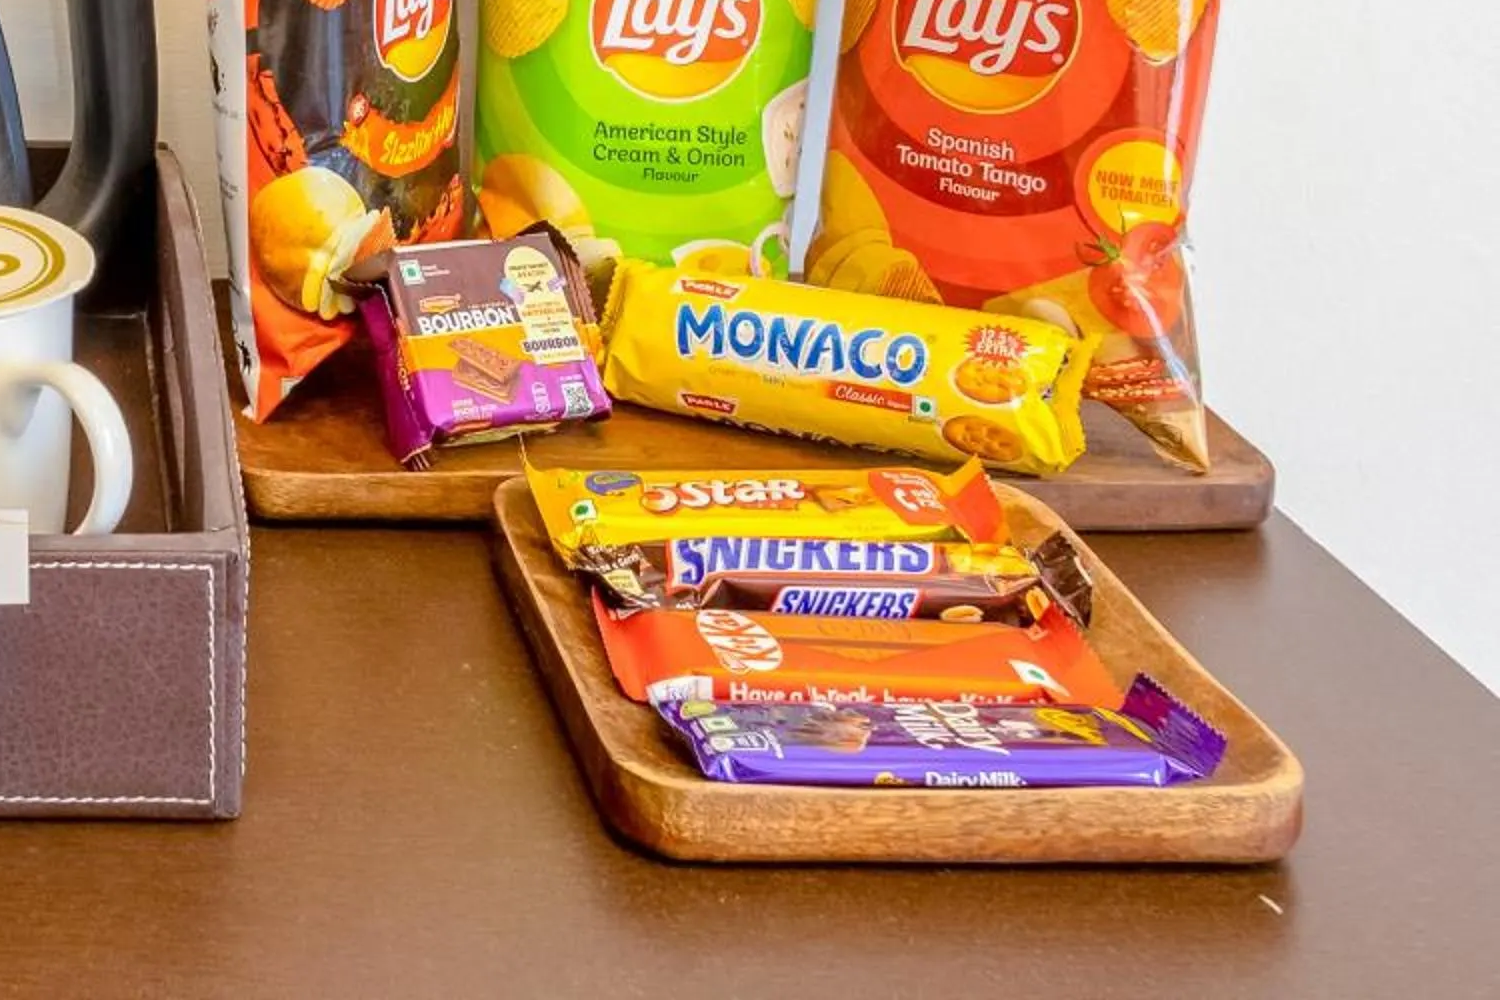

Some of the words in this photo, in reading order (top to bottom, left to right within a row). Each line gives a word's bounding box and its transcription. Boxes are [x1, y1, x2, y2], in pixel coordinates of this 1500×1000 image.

[593, 120, 692, 142] American
[696, 125, 748, 151] Style
[927, 127, 1015, 162] Spanish
[593, 143, 661, 163] Cream
[666, 147, 682, 165] &
[687, 147, 746, 167] Onion
[896, 144, 974, 178] Tomato
[979, 161, 1048, 196] Tango
[642, 167, 701, 183] Flavour
[939, 177, 1001, 202] Flavour
[416, 306, 516, 336] BOURBON
[677, 303, 927, 385] MONACO
[835, 384, 886, 405] Classic
[674, 537, 932, 585] SNICKERS
[777, 587, 915, 617] SNICKERS
[925, 770, 979, 787] Dairy
